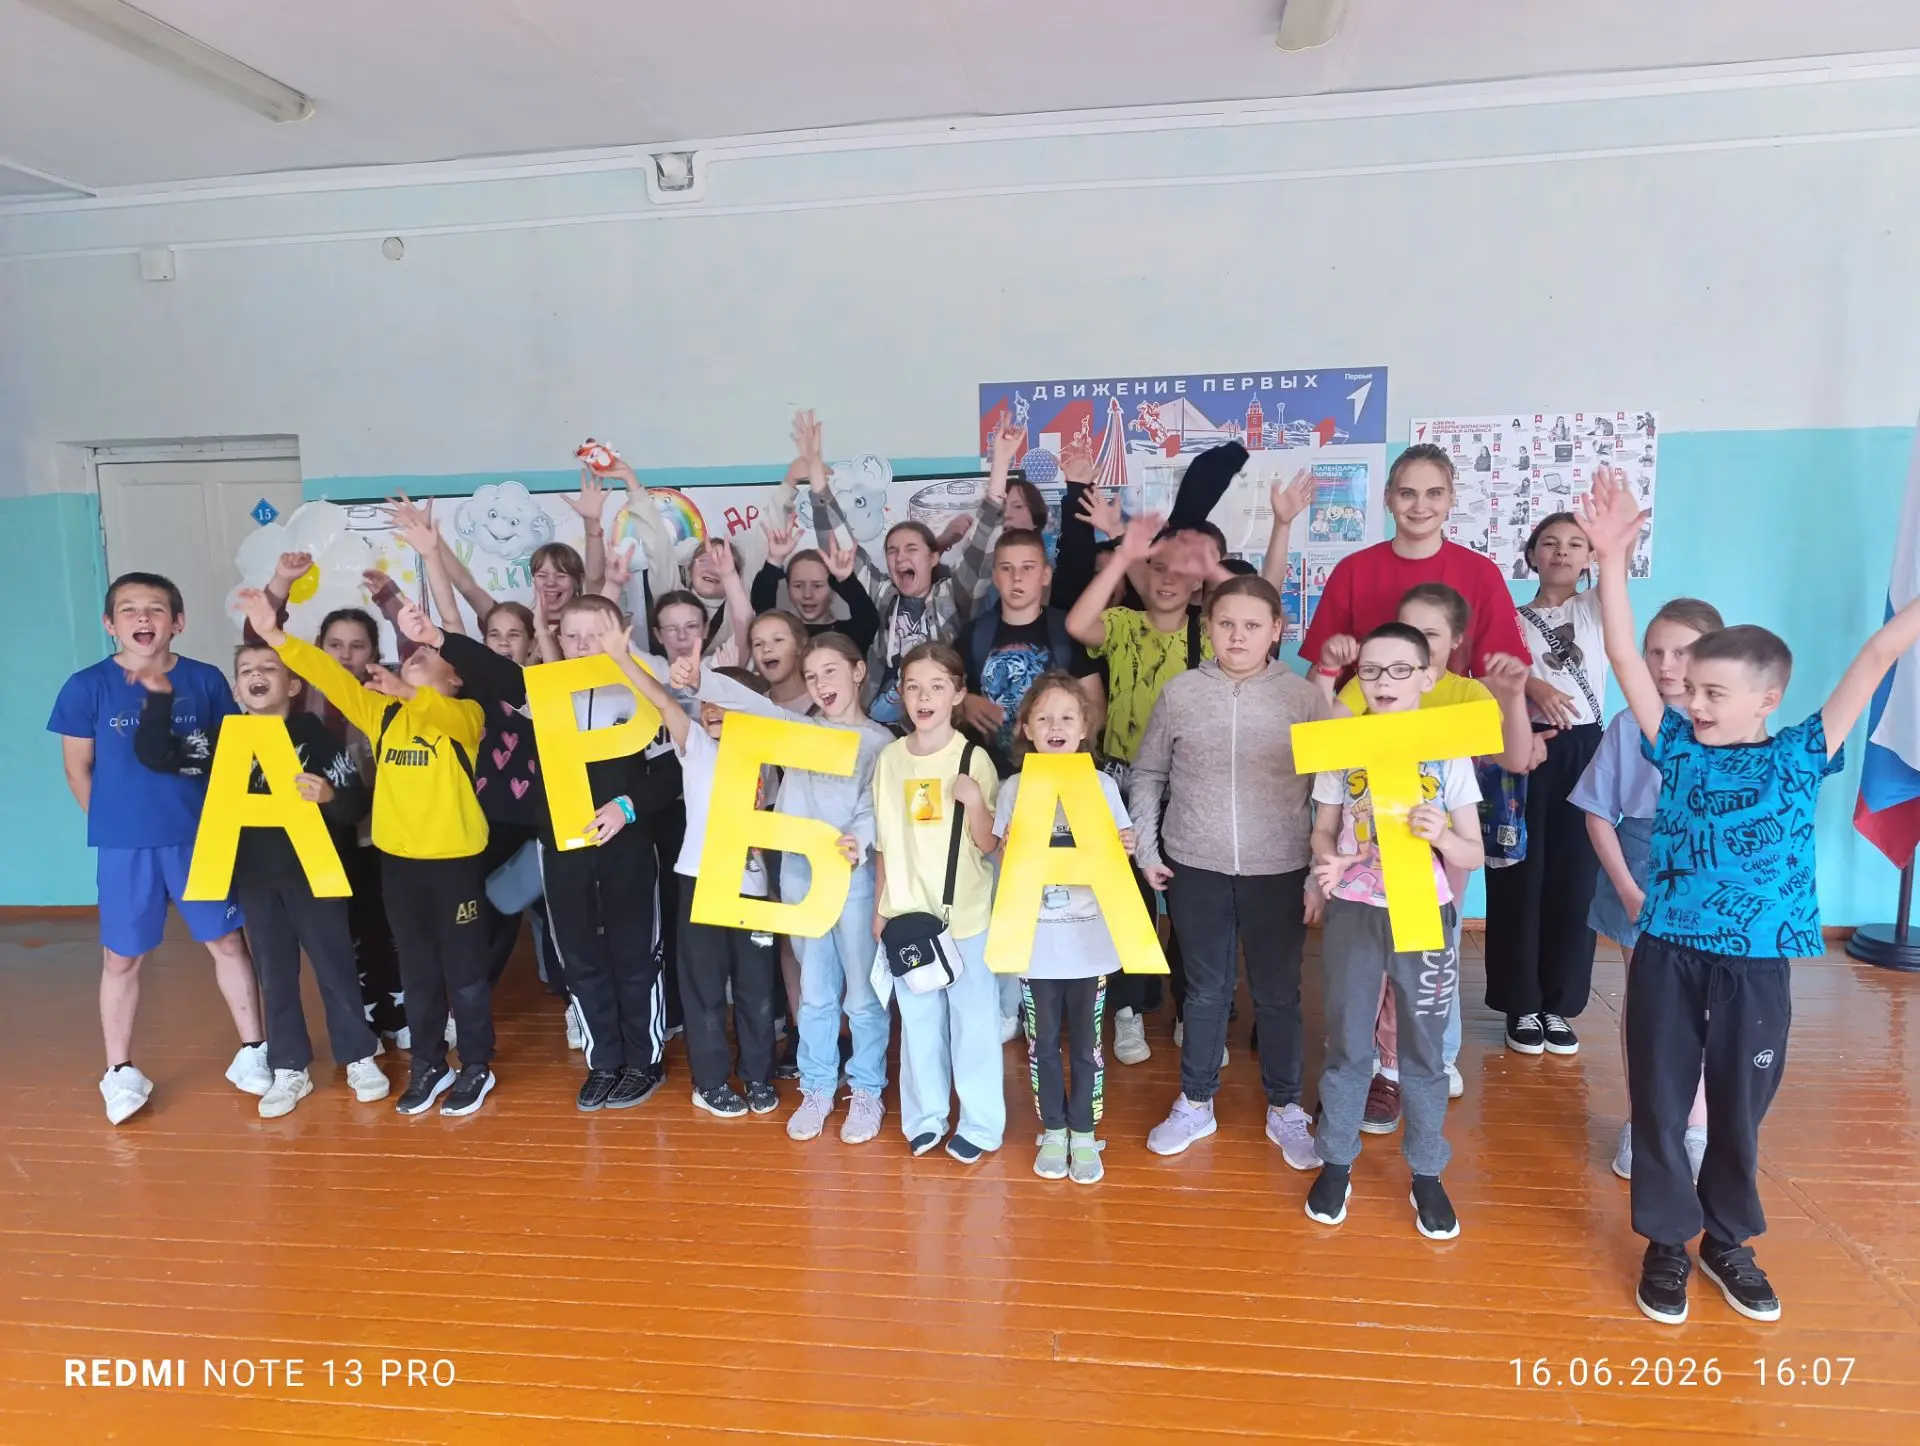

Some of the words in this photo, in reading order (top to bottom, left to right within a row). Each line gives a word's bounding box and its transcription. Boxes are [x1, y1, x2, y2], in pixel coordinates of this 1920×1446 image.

[1032, 380, 1187, 401] ДВИЖЕНИЕ
[1203, 374, 1319, 393] ПЕРВЫХ
[258, 509, 272, 521] 15
[183, 715, 353, 901] А
[523, 653, 664, 851] Р
[689, 711, 861, 939] Б
[983, 752, 1171, 975] А
[1290, 699, 1505, 953] Т
[1777, 865, 1812, 900] URBAN
[1092, 1070, 1104, 1098] LOVE
